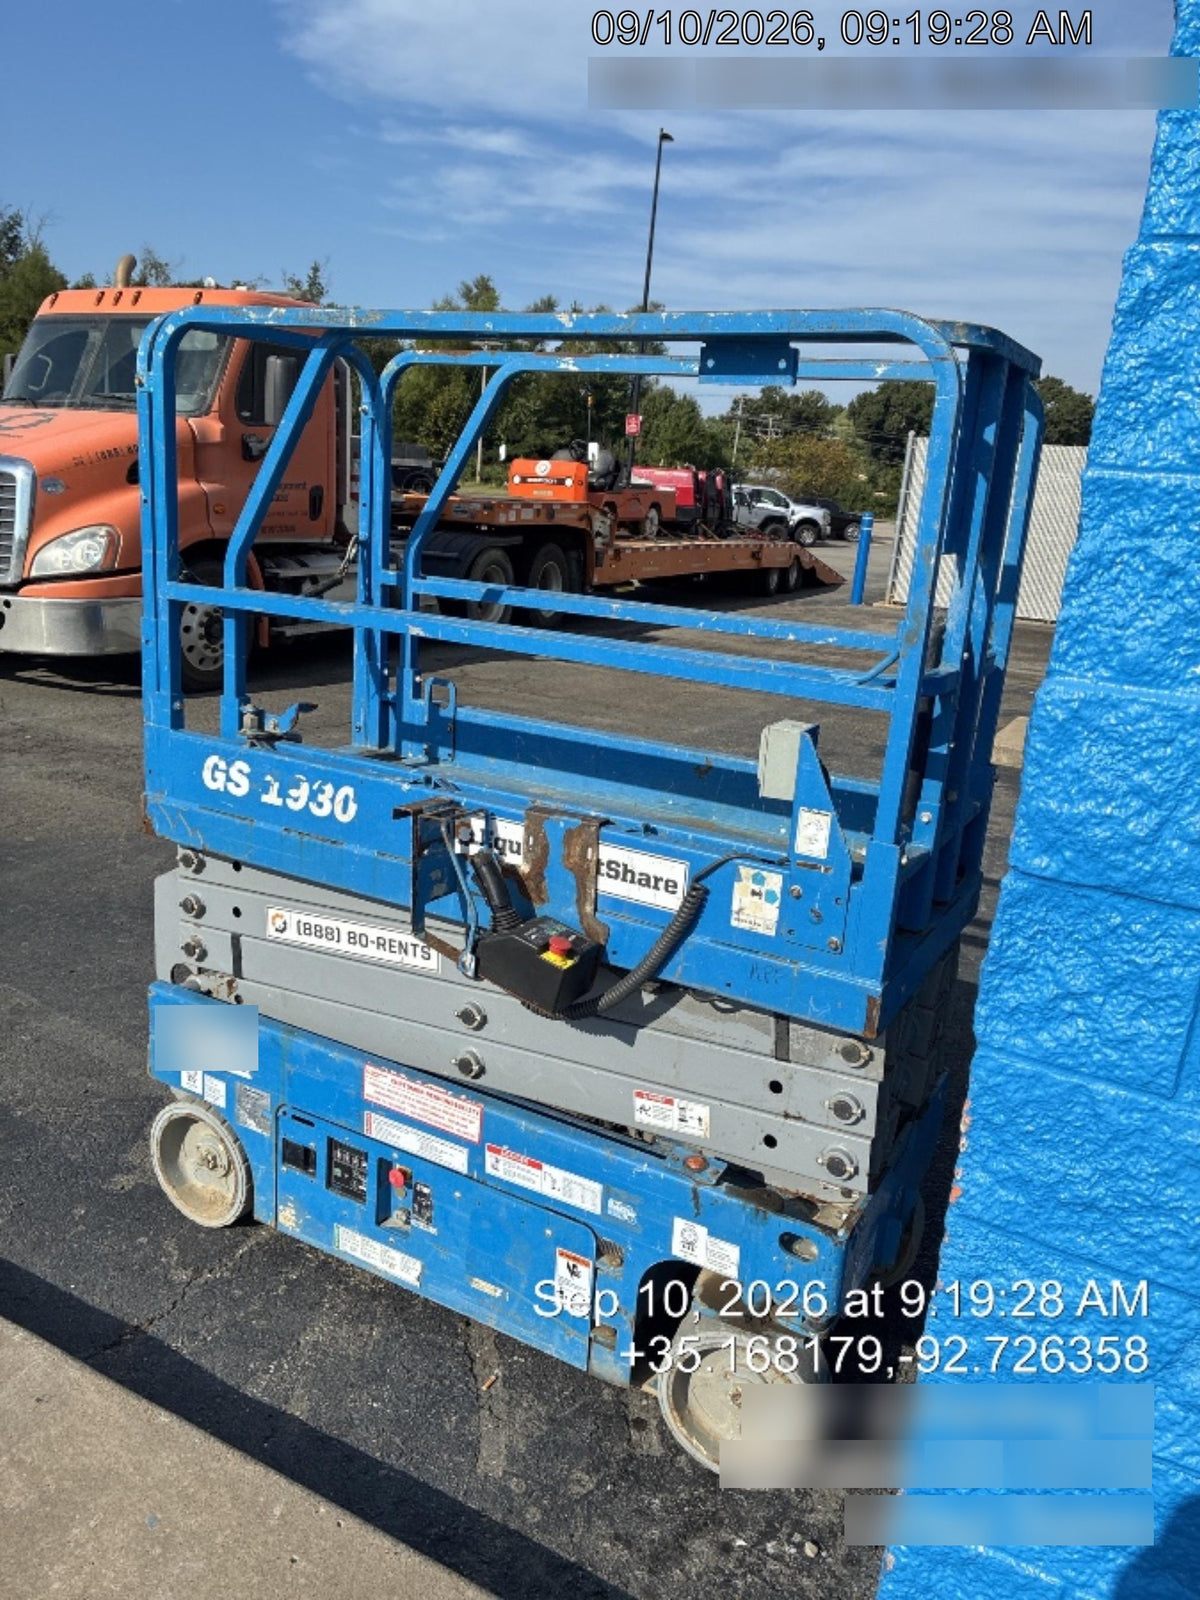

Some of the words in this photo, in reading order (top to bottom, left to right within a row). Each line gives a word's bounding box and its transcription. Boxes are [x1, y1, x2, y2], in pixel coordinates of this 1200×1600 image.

[202, 755, 251, 797] GS
[260, 774, 358, 823] 1930
[296, 919, 341, 943] (888)
